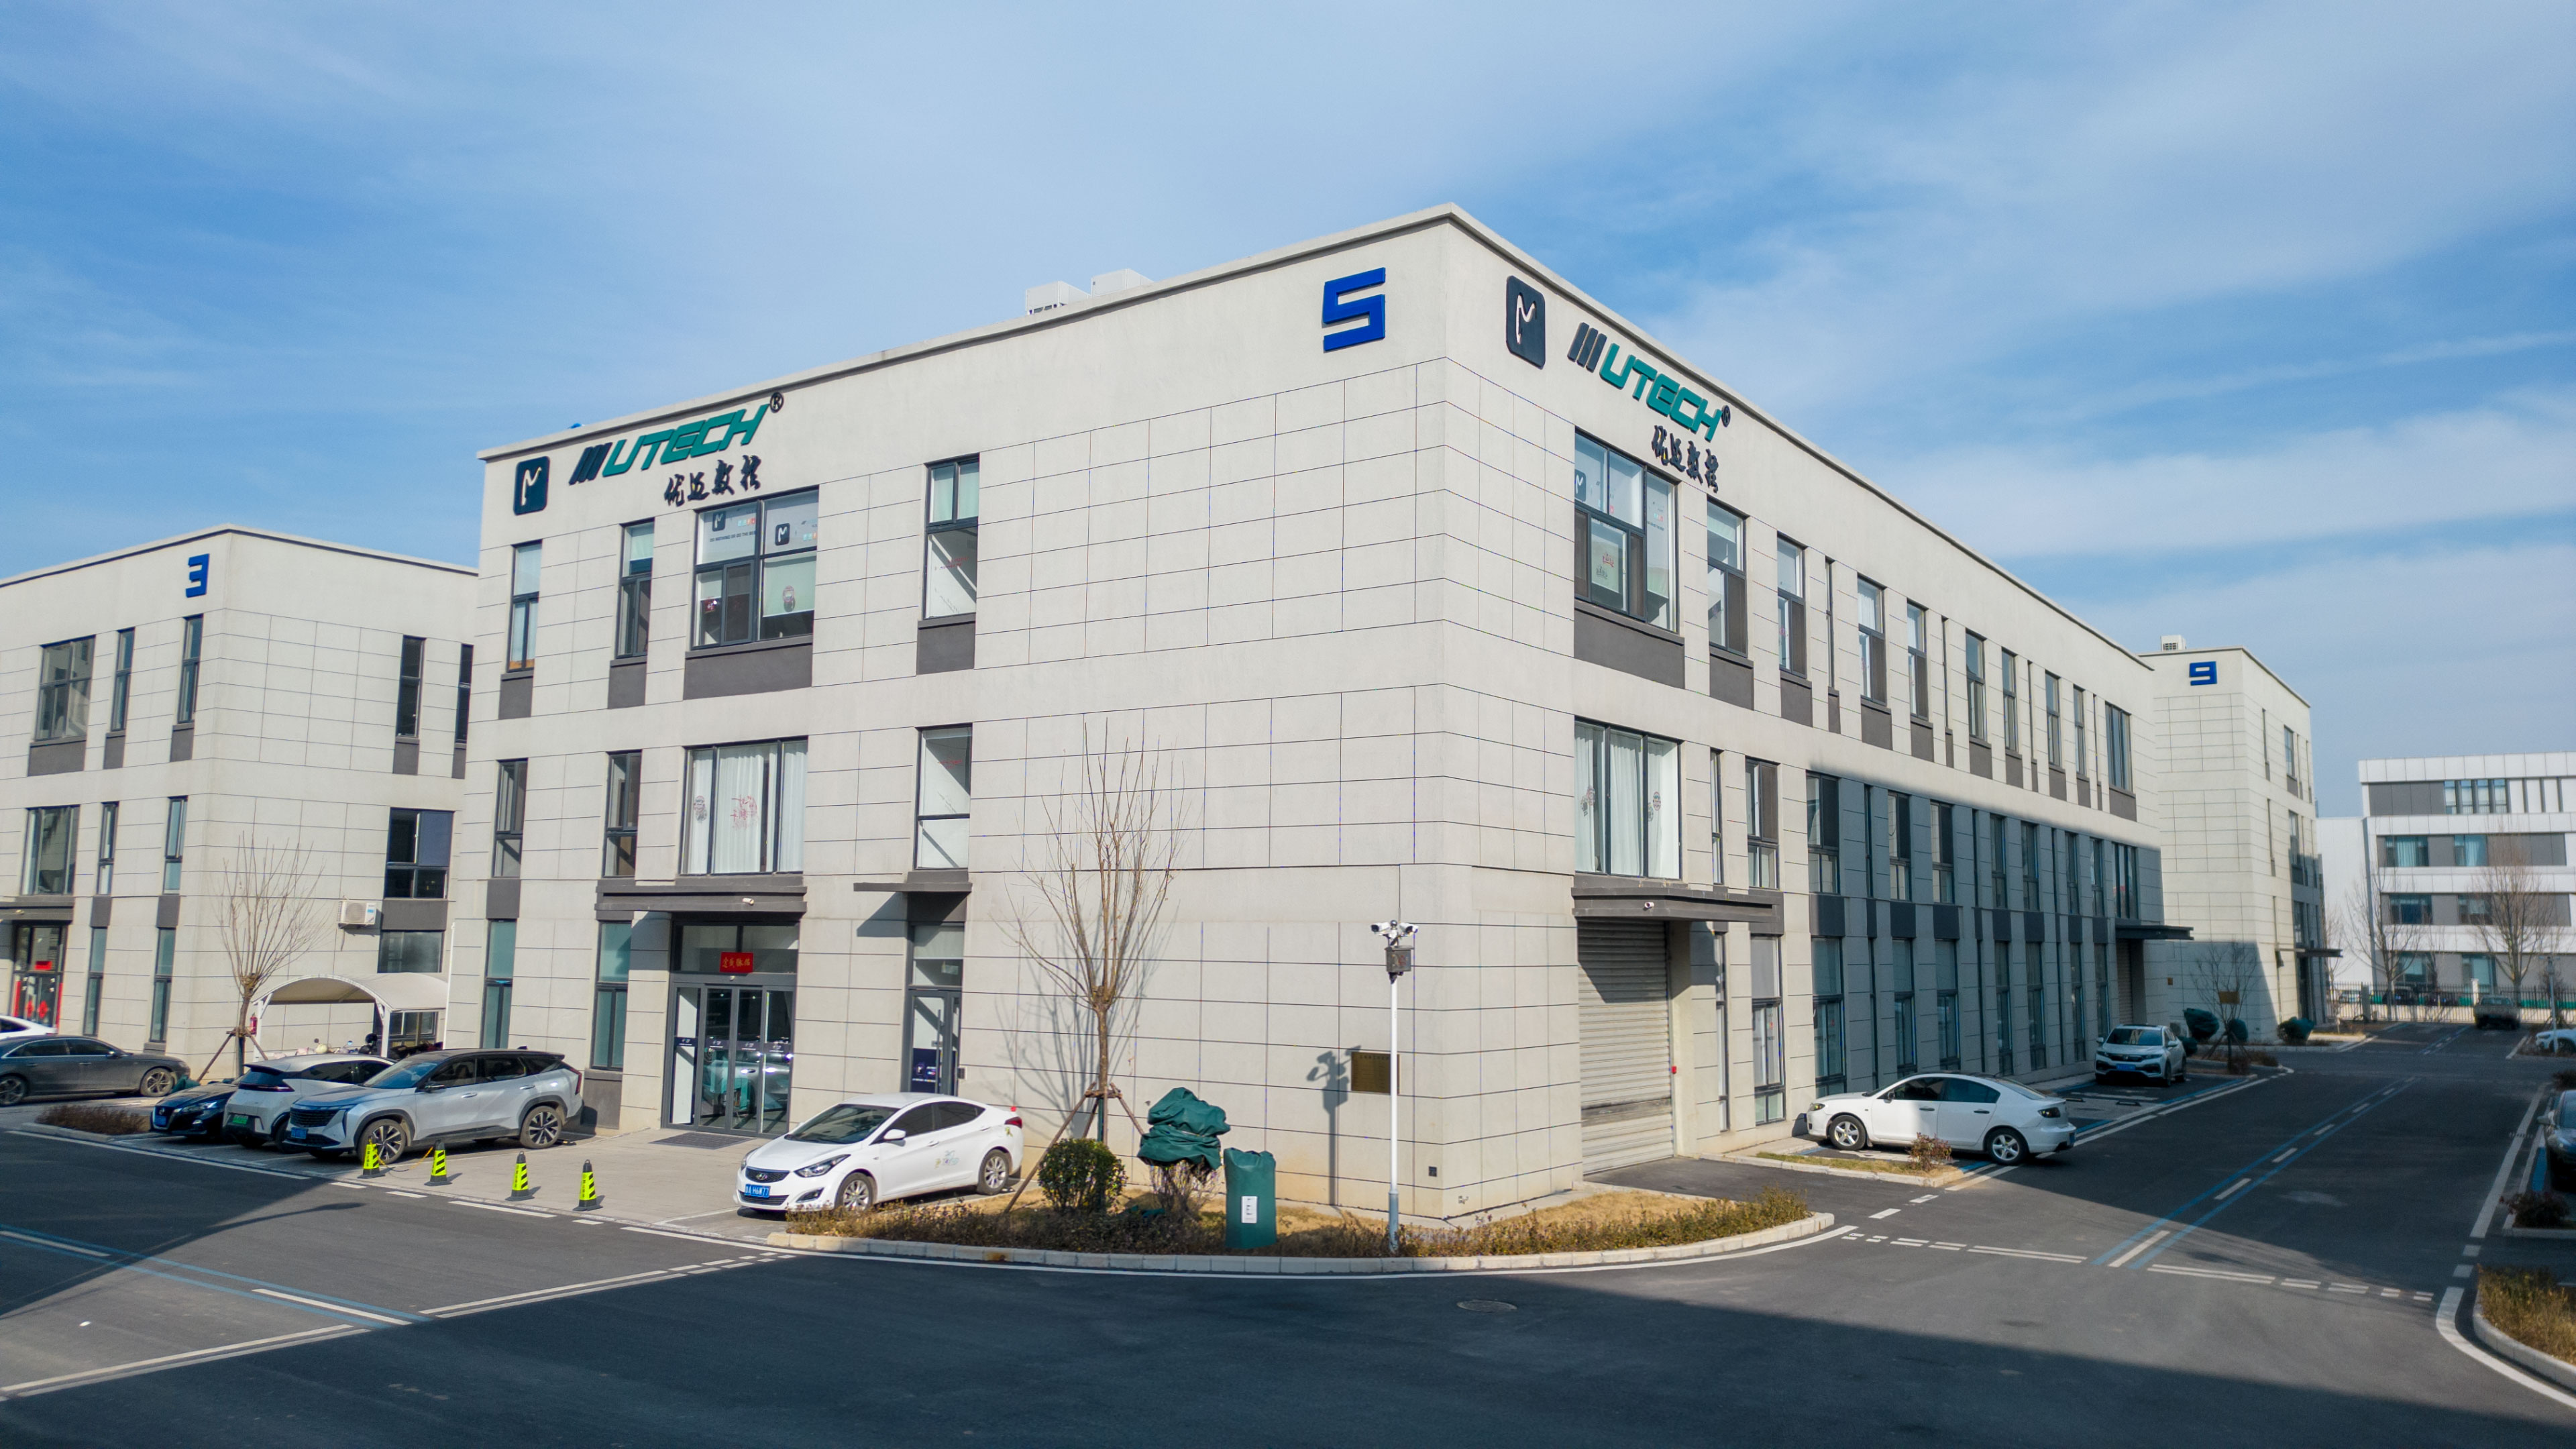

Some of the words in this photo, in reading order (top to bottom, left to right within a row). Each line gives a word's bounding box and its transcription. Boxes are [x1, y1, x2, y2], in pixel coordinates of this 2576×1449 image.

[1323, 267, 1385, 352] 5
[186, 553, 209, 598] 3
[2189, 661, 2217, 686] 9
